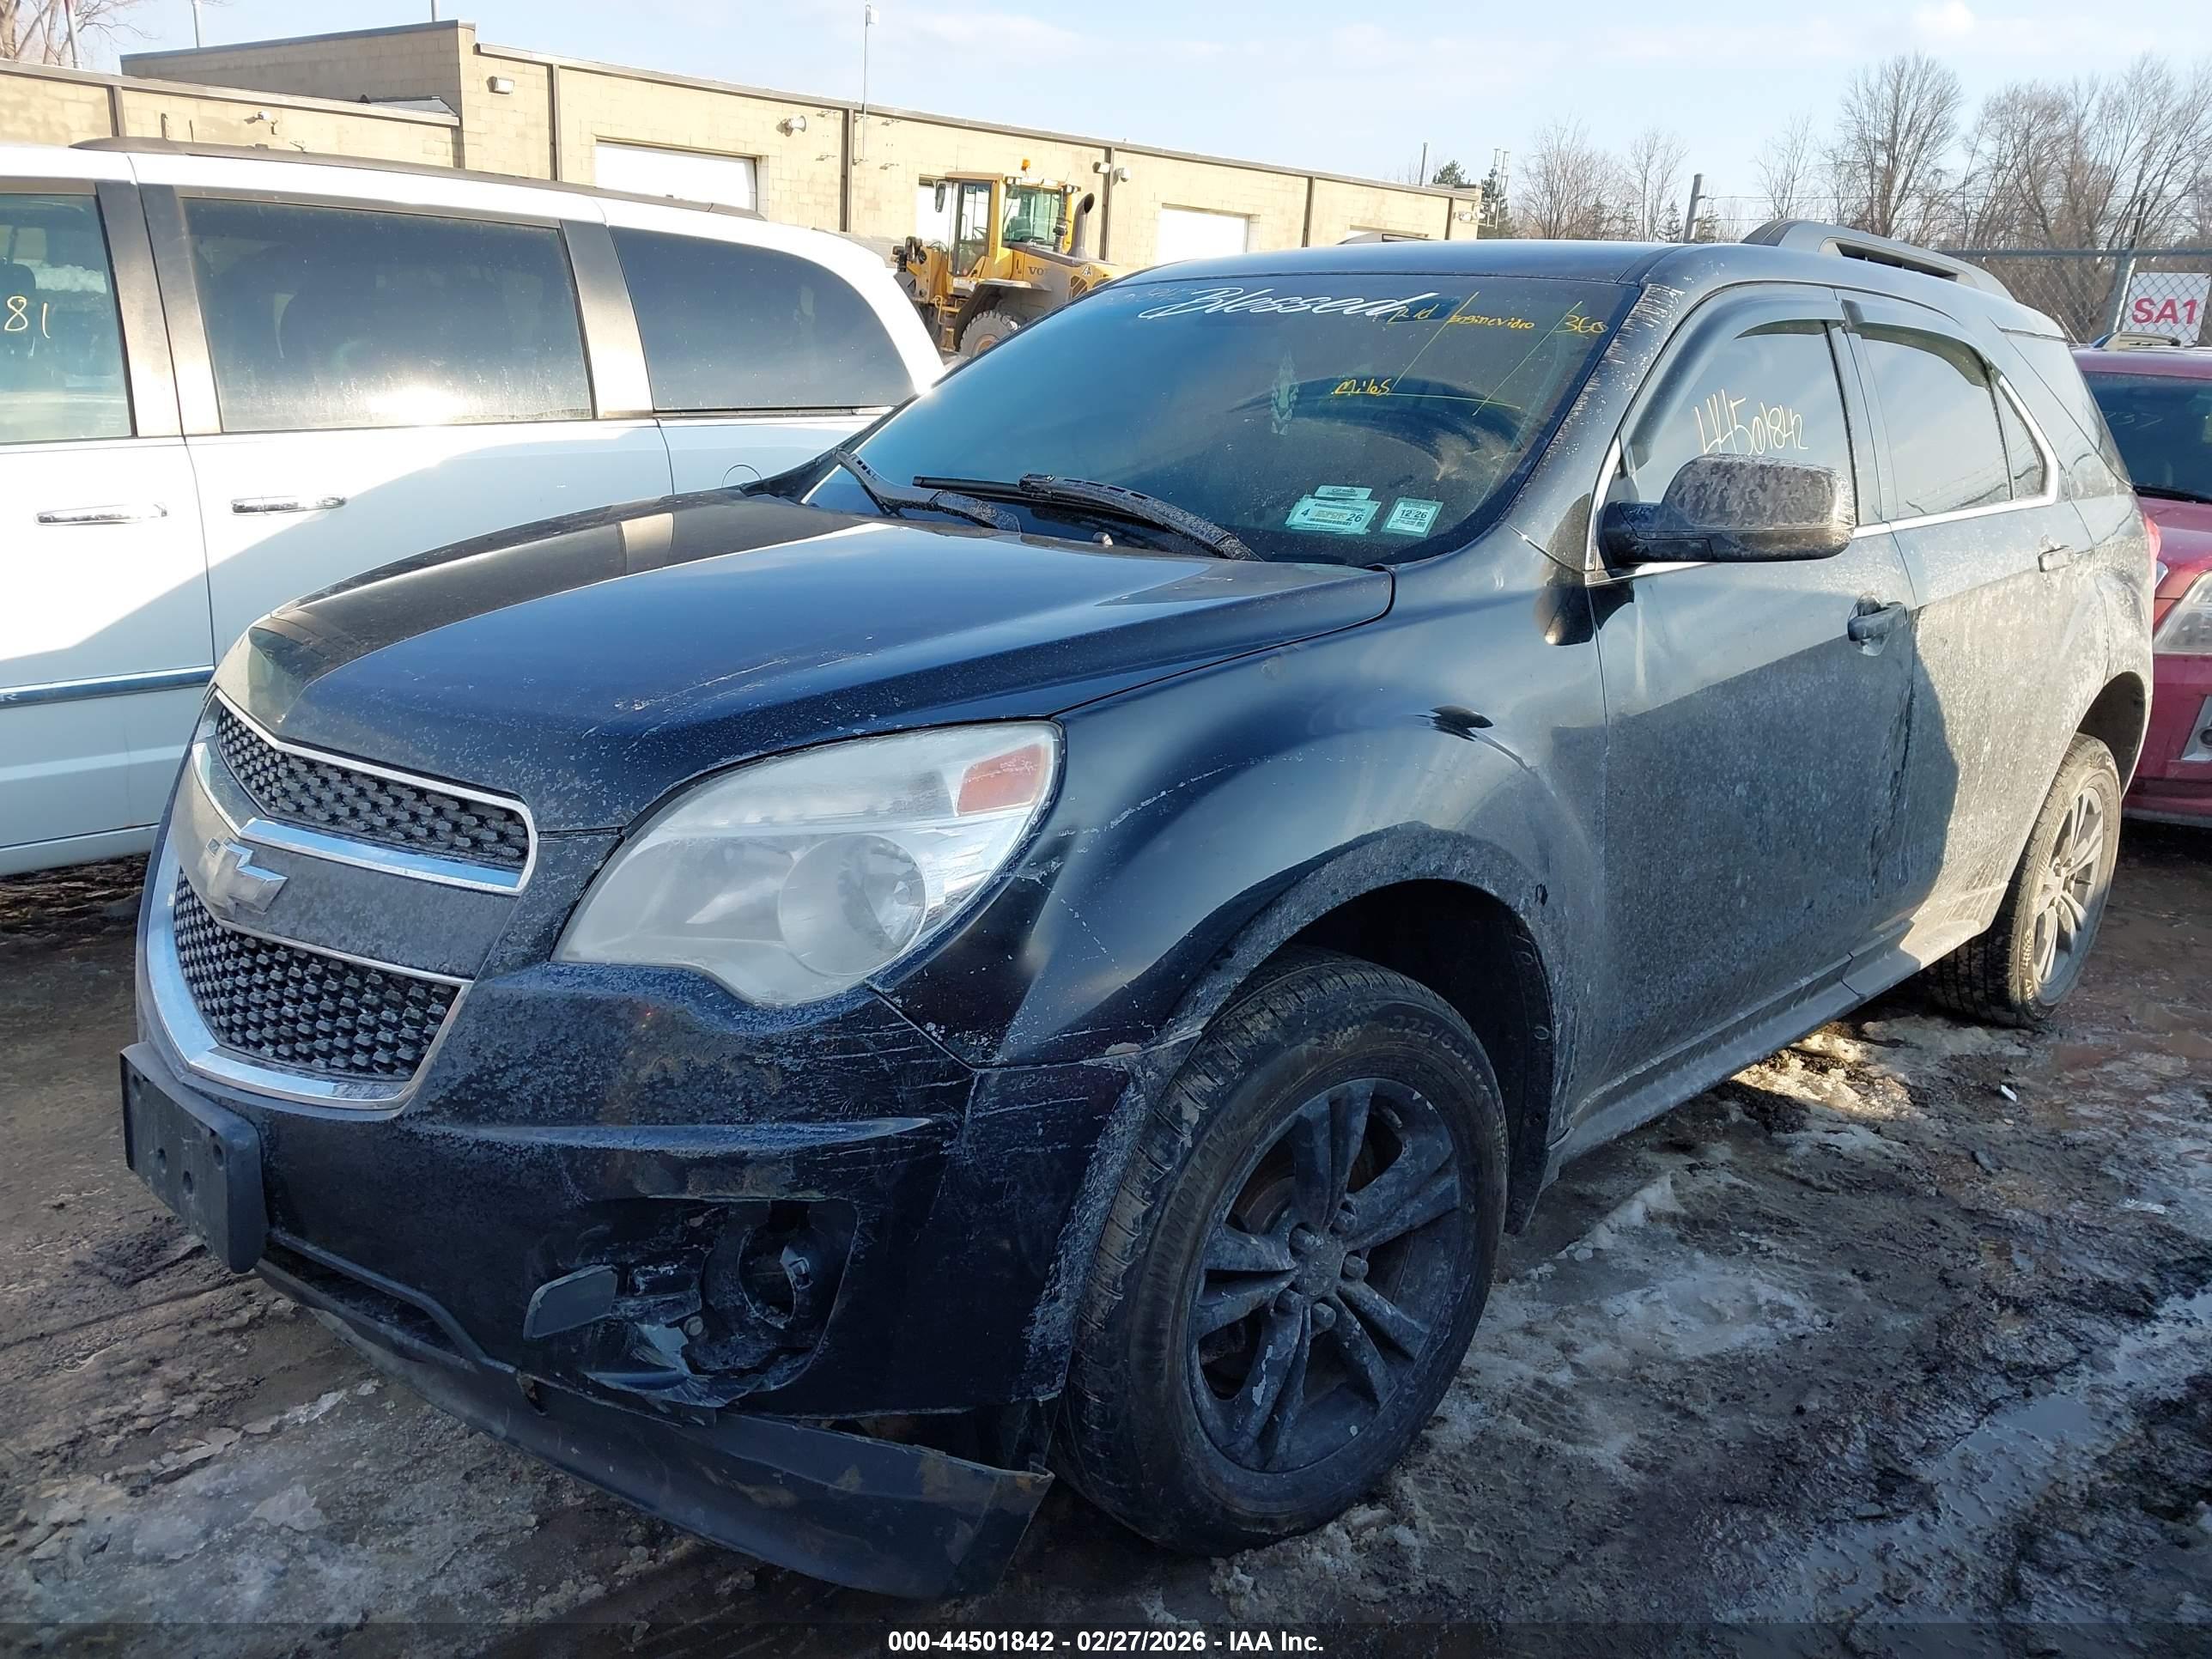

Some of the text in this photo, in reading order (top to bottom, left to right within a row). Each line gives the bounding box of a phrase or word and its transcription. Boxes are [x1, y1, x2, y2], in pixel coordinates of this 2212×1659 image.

[1138, 287, 1440, 319] Blessed
[2131, 297, 2198, 325] SA1
[1694, 388, 1809, 457] 44501842
[1301, 507, 1311, 517] 4
[1346, 513, 1364, 523] 26
[1401, 508, 1413, 517] 12
